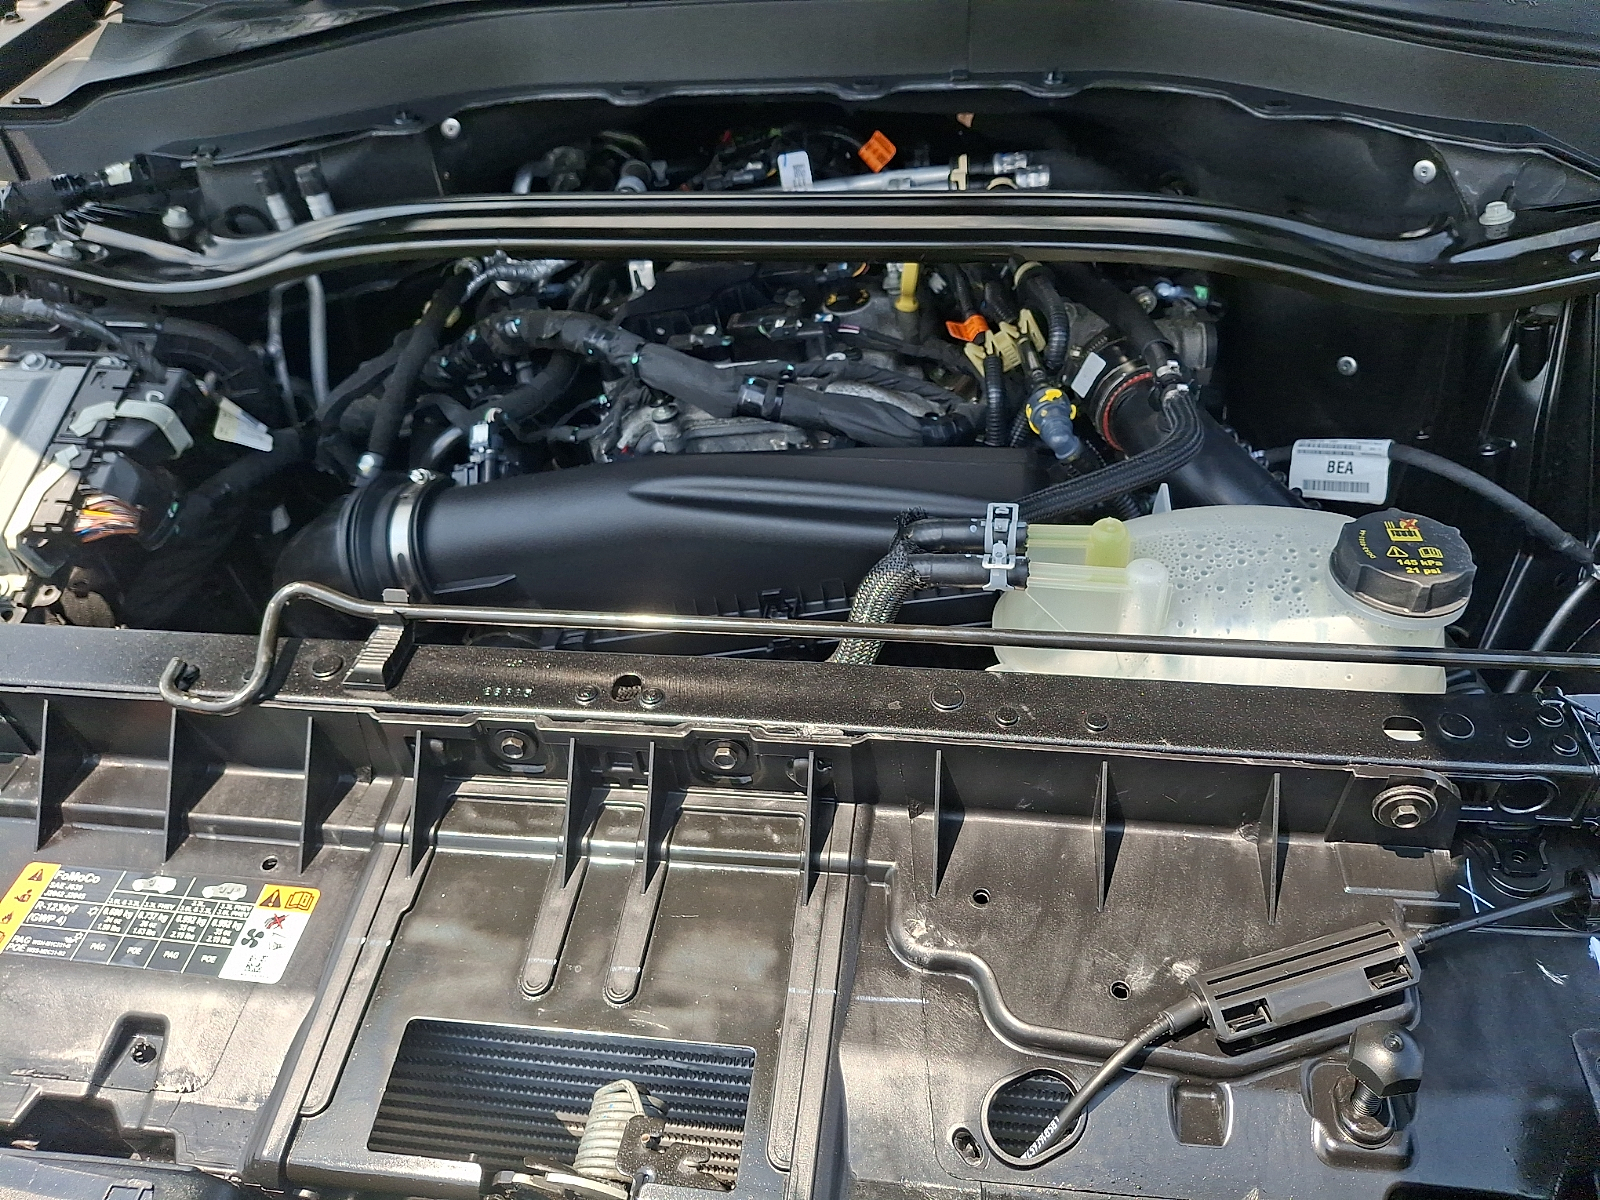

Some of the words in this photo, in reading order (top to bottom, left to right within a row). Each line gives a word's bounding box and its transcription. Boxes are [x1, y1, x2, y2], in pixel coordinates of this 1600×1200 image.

[1327, 460, 1354, 475] BEA
[1420, 559, 1443, 567] kPa
[1405, 566, 1420, 574] 21
[1423, 567, 1441, 575] psi
[54, 870, 101, 884] FoMoCo
[49, 881, 65, 889] SAE
[34, 901, 79, 915] R-1234yf
[25, 912, 56, 924] (GWP
[11, 934, 32, 945] PAG
[6, 942, 27, 952] POE
[89, 942, 107, 951] PAG
[126, 946, 143, 955] POE
[162, 950, 179, 960] PAG
[200, 954, 218, 964] POE
